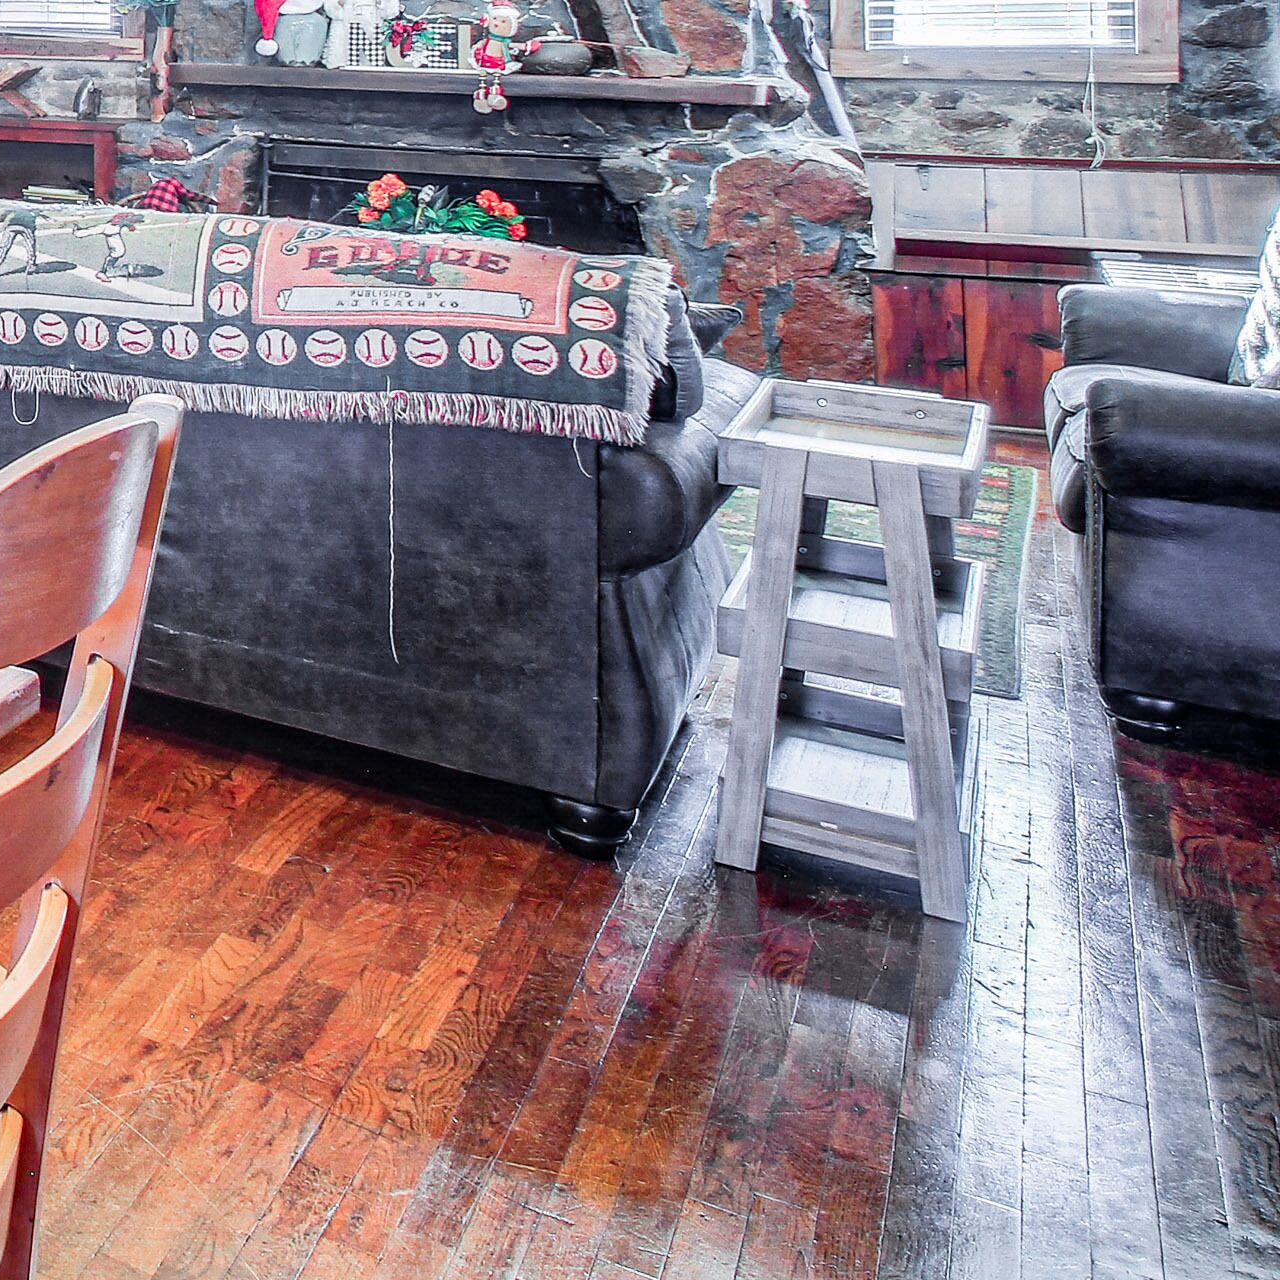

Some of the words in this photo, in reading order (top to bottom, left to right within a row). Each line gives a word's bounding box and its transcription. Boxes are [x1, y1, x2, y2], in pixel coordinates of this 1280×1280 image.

[302, 242, 515, 275] GUDE
[350, 289, 412, 298] PUBLISHED
[426, 291, 442, 299] BY
